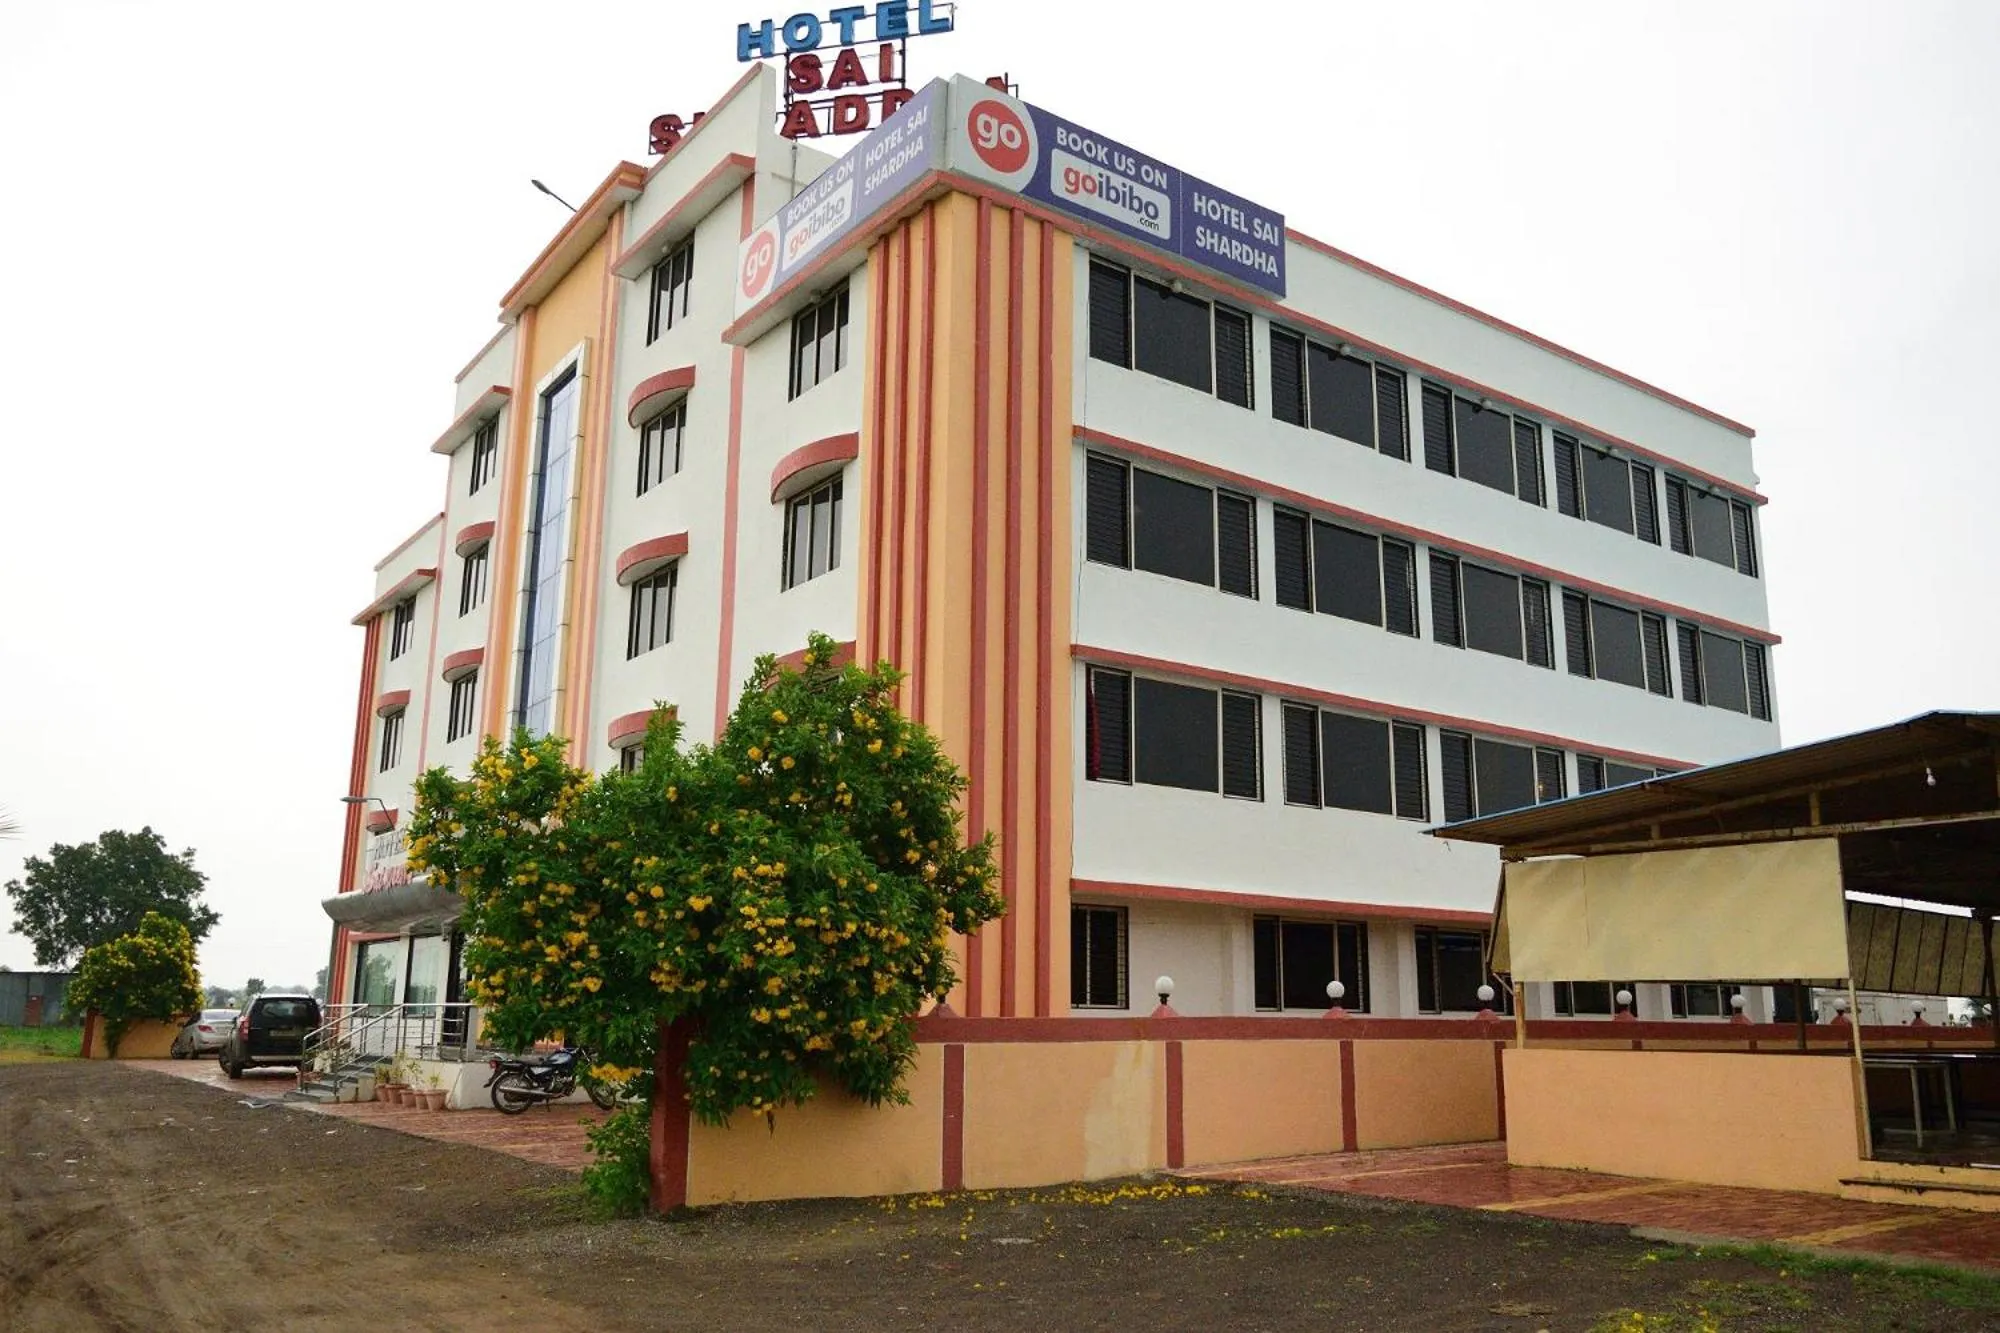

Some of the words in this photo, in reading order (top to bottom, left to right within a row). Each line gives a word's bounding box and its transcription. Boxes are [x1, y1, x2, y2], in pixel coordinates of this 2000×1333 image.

[737, 0, 950, 61] HOTEL
[788, 43, 893, 94] SAI
[865, 133, 904, 170] HOTEL
[906, 105, 928, 135] SAI
[976, 112, 1021, 150] go
[1056, 126, 1109, 165] BOOK
[1113, 152, 1136, 178] US
[1140, 164, 1168, 190] ON
[786, 192, 818, 227] BOOK
[819, 175, 834, 197] US
[836, 155, 854, 183] ON
[863, 136, 924, 196] SHARDHA
[1063, 164, 1159, 221] goibibo
[788, 197, 845, 260] goibibo
[1192, 192, 1249, 235] HOTEL
[1252, 218, 1279, 247] SAI
[745, 244, 771, 286] go
[1194, 226, 1278, 279] SHARDHA
